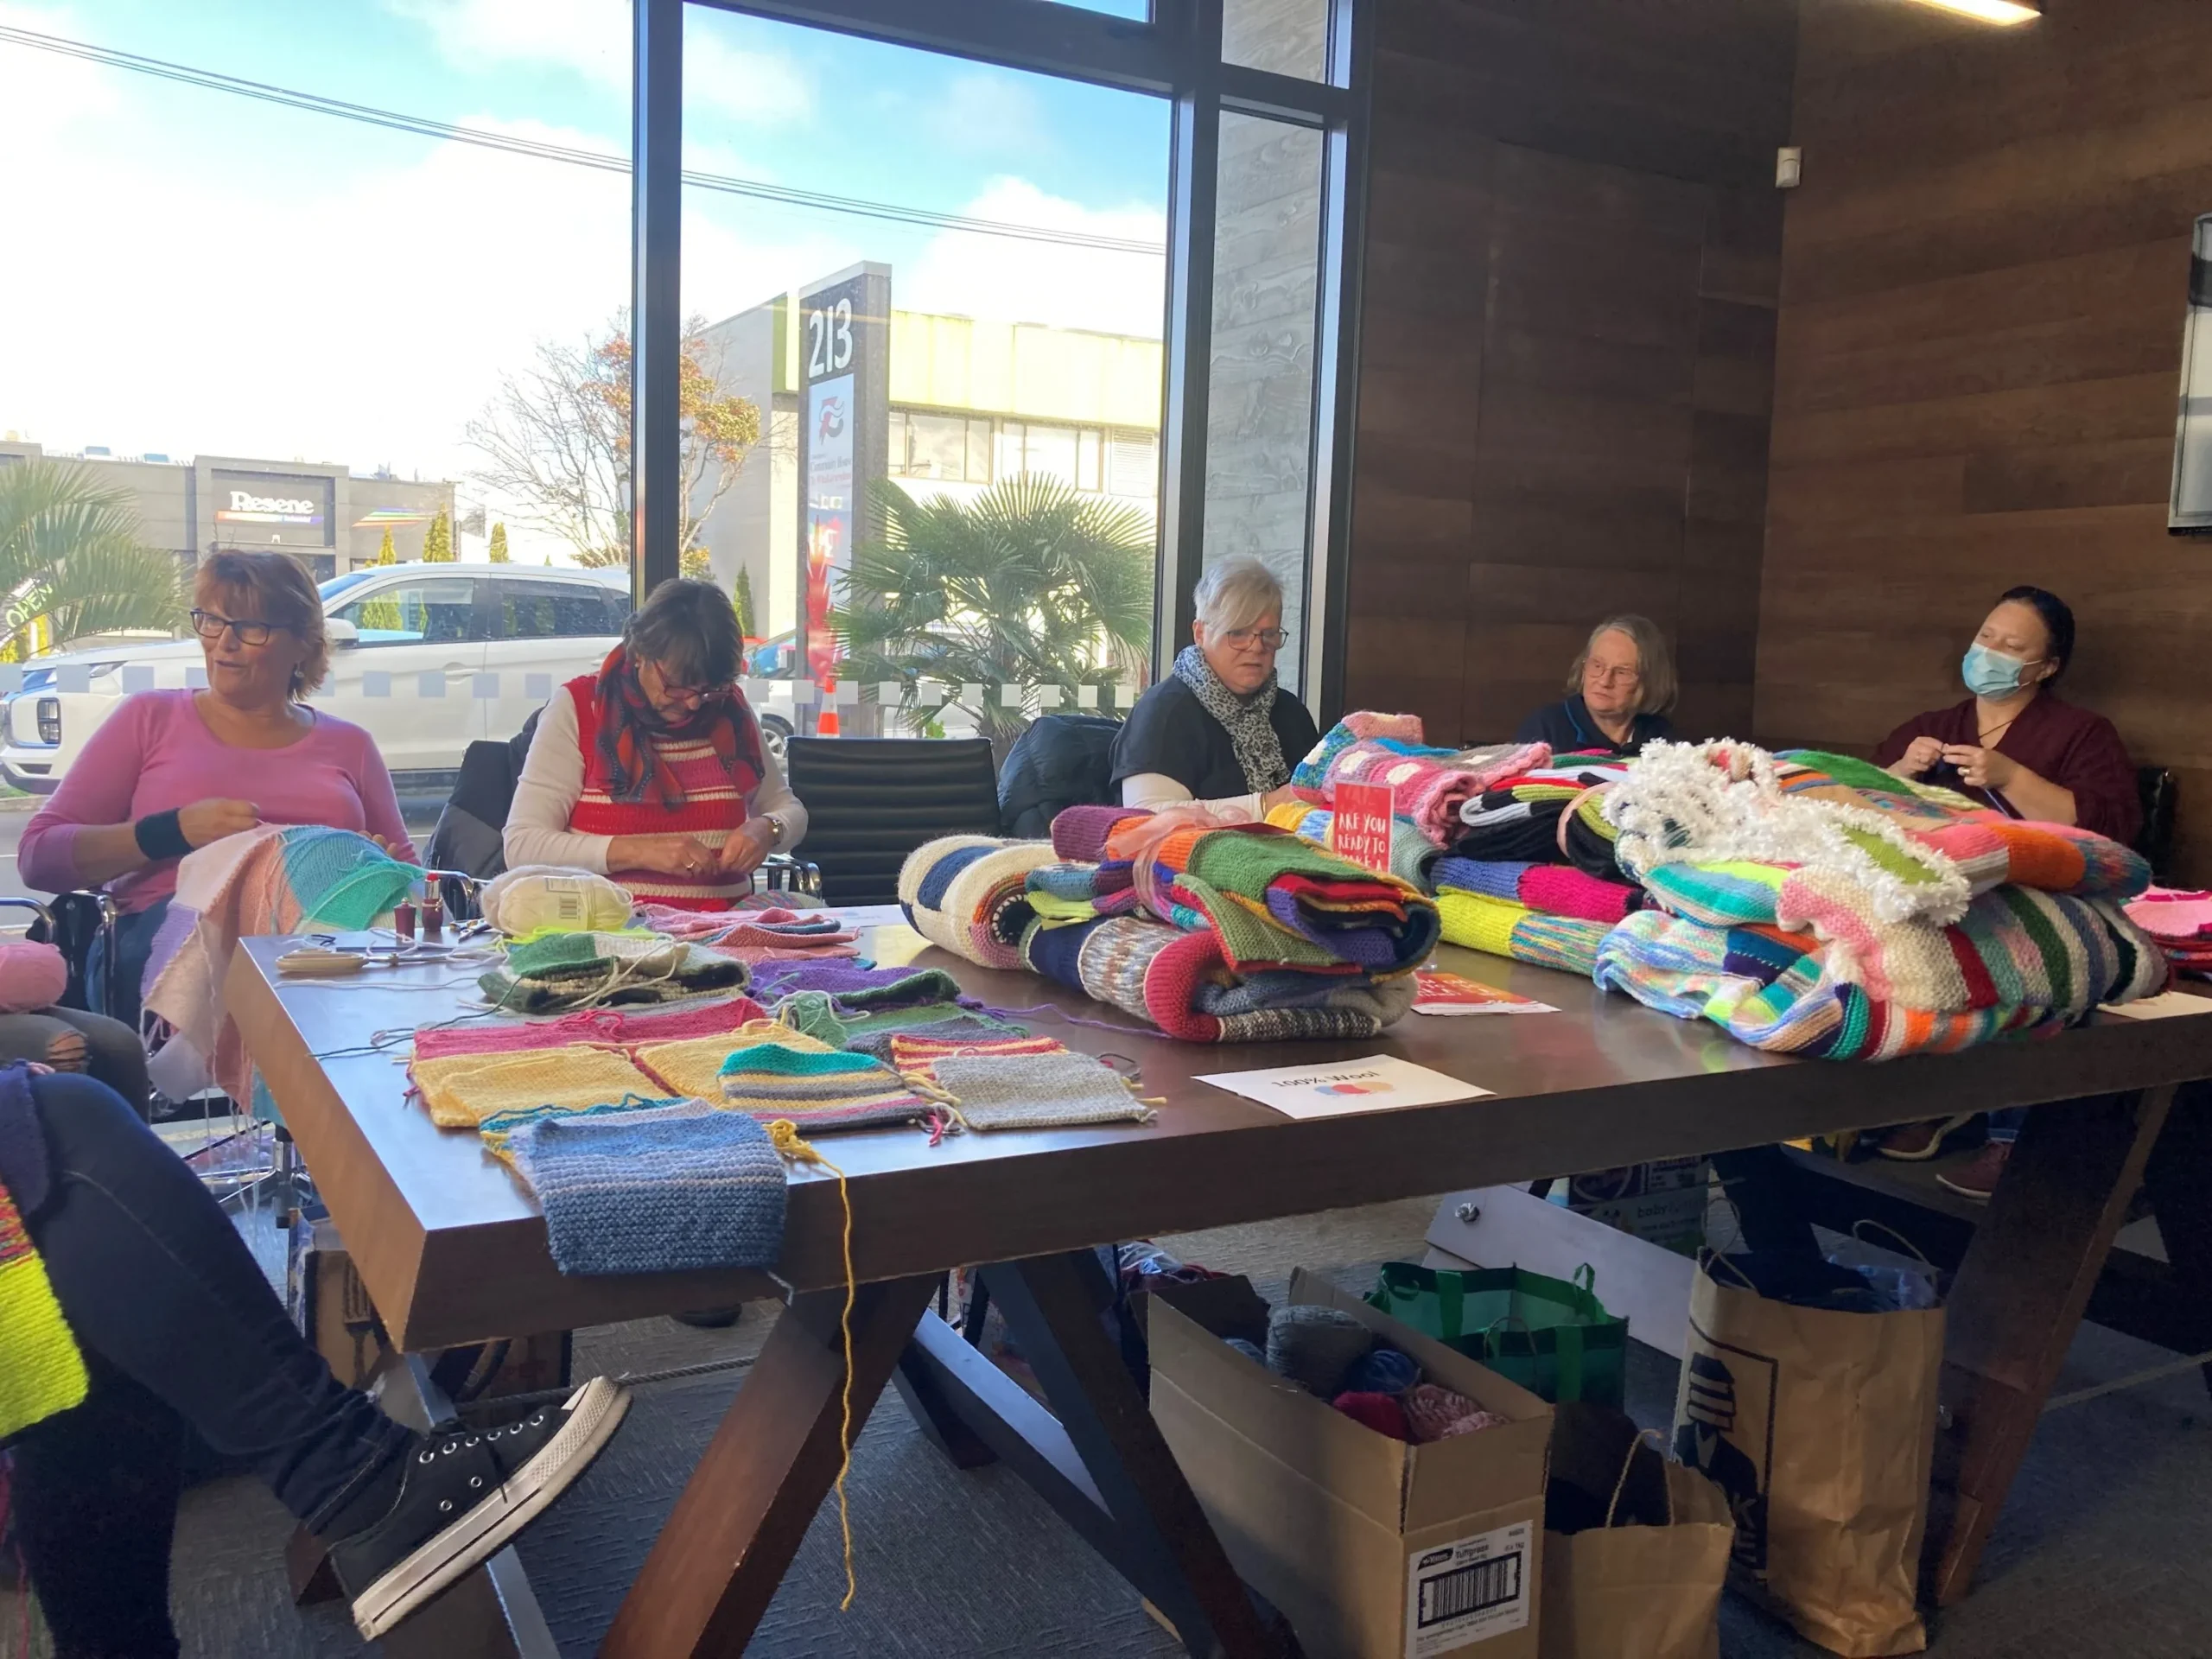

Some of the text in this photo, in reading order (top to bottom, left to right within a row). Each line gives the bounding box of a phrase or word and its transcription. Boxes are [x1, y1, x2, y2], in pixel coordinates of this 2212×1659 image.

[808, 297, 853, 378] 213
[229, 491, 315, 514] Resene
[1338, 812, 1386, 834] ARE YOU
[1338, 834, 1386, 855] READY TO
[1272, 1071, 1382, 1087] 100% Wool
